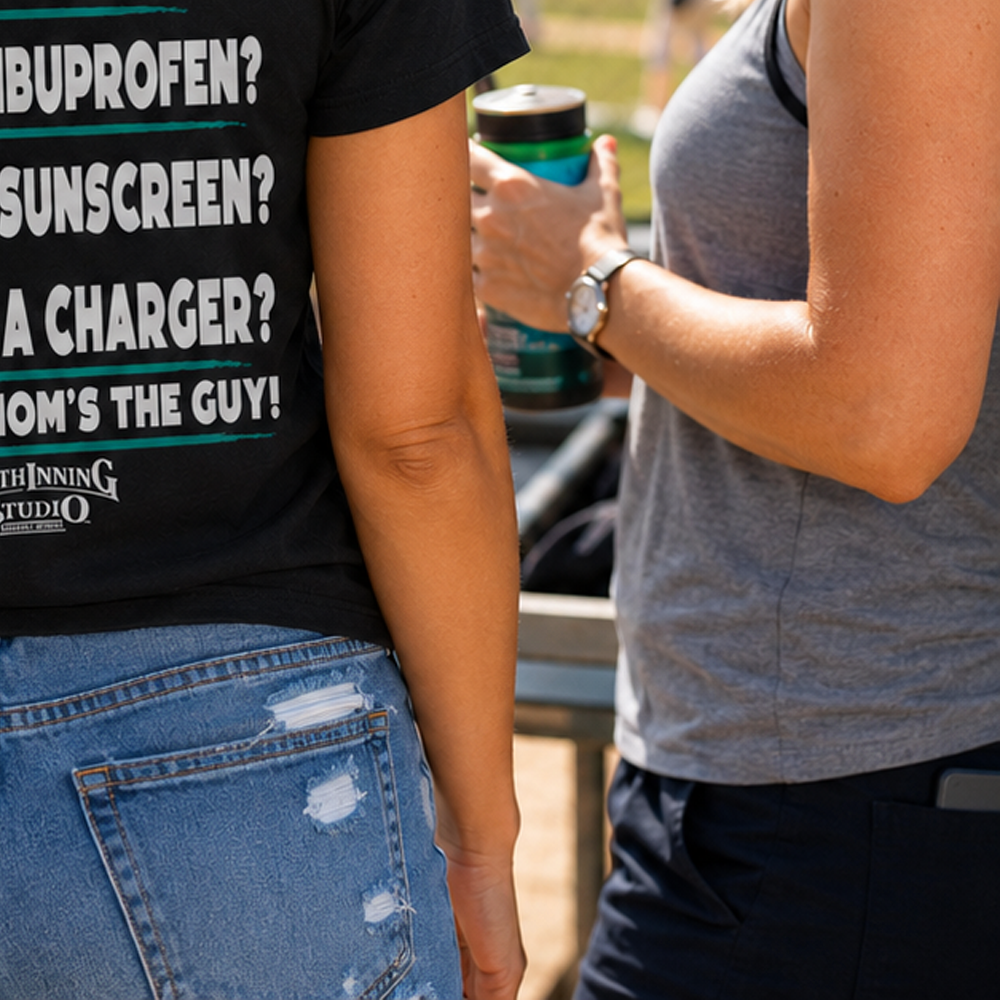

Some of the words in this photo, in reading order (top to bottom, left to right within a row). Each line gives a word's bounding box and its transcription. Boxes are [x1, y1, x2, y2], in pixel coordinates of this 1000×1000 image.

[2, 289, 35, 357] A
[45, 273, 276, 356] CHARGER?
[110, 383, 182, 428] THE
[192, 376, 281, 425] GUY!
